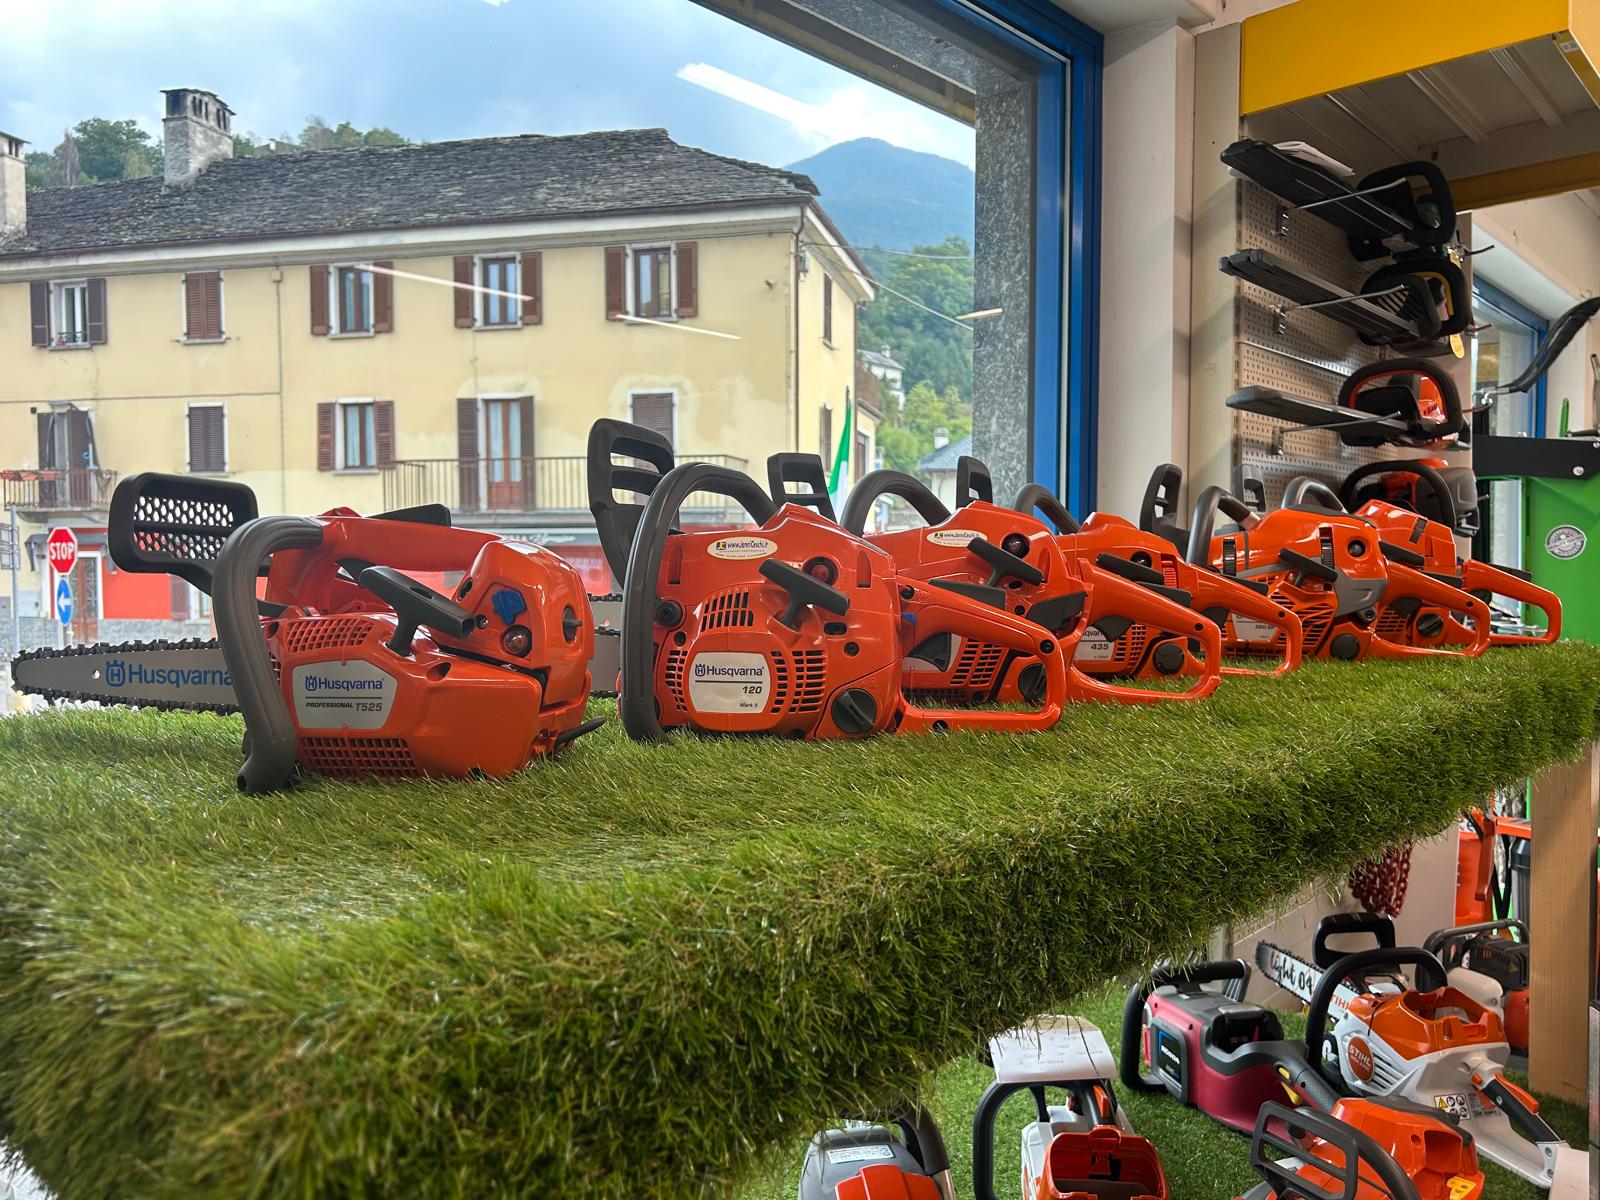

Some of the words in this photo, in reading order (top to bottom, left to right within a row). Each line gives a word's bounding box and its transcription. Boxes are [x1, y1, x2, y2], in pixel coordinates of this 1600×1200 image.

[49, 542, 74, 560] STOP
[128, 663, 233, 688] Husqvarna
[706, 665, 763, 677] Husqvarna
[318, 677, 383, 691] Husqvarna
[742, 686, 762, 694] 120
[355, 702, 383, 712] T525
[1349, 1044, 1371, 1067] STIHL
